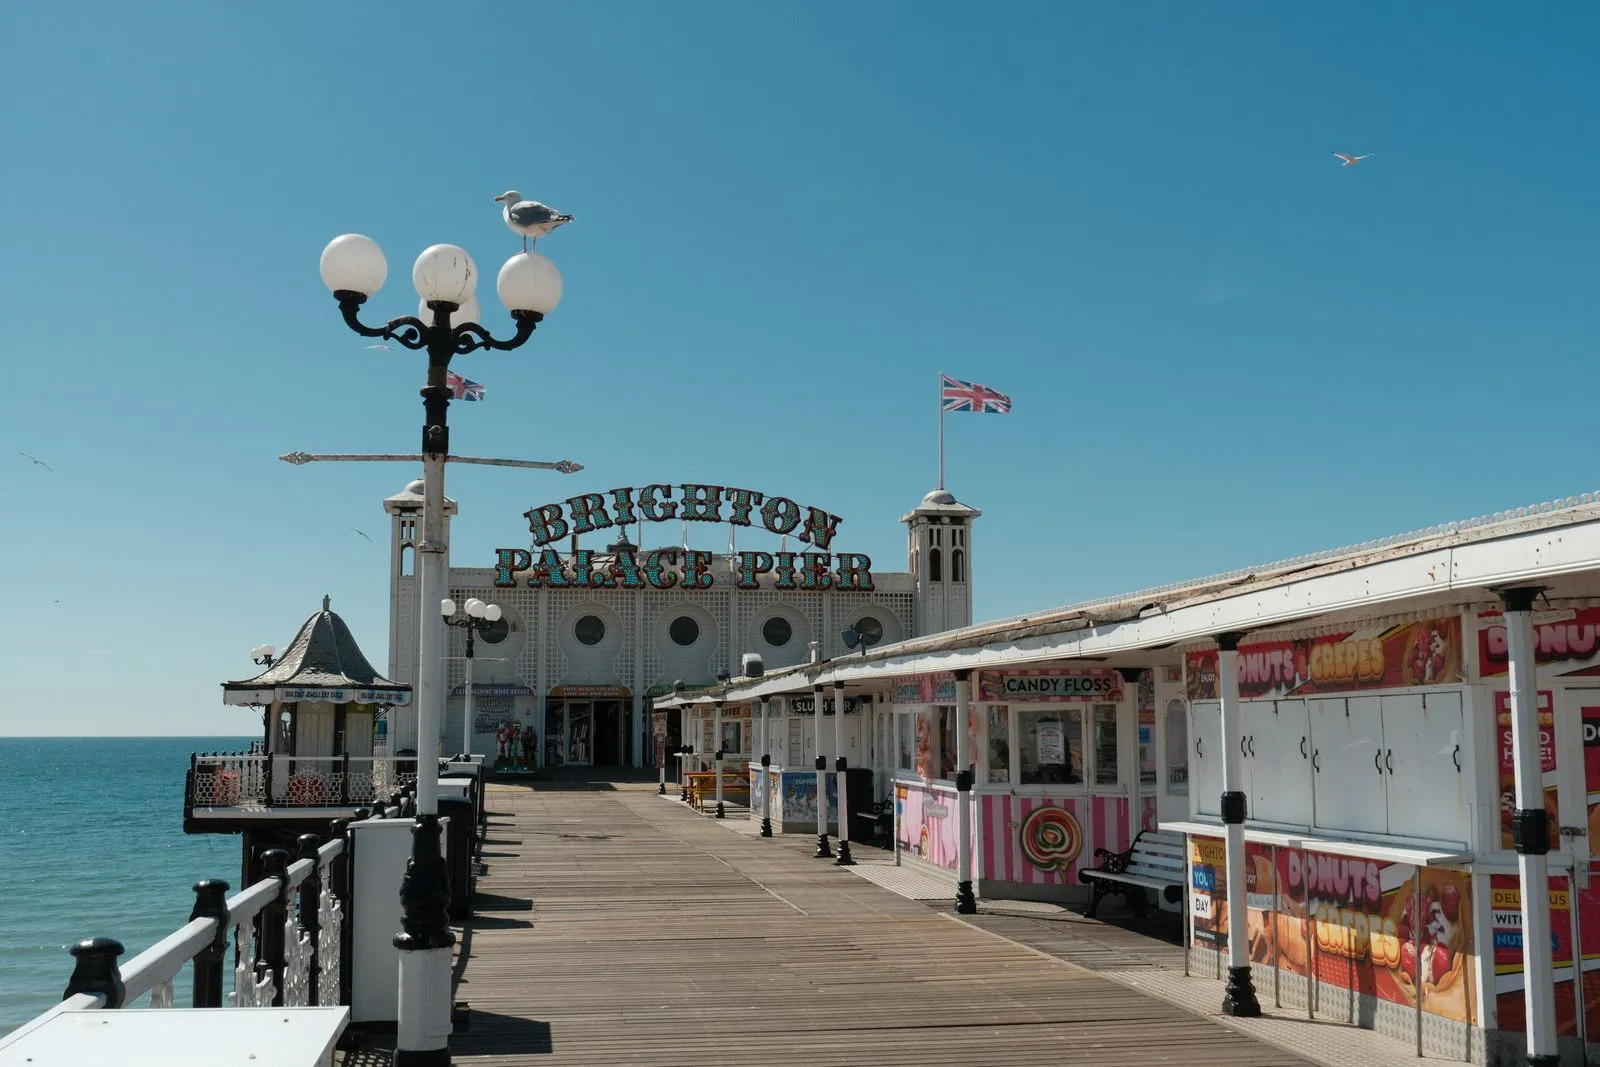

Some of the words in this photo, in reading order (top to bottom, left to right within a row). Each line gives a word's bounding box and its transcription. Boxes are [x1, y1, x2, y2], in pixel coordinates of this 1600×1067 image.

[523, 484, 843, 550] BRIGHTON
[494, 548, 714, 589] PALACE
[737, 551, 875, 592] PIER
[1487, 624, 1600, 655] DNU
[1238, 649, 1294, 683] ONUTS
[1006, 678, 1061, 692] CANDY
[1064, 678, 1112, 692] FLOSS
[721, 708, 741, 717] OFFEE
[796, 701, 828, 712] SLUH
[831, 700, 851, 711] BR
[1503, 731, 1550, 744] SD
[1503, 748, 1552, 760] HE!
[1194, 844, 1225, 860] BRIGHTO
[1194, 870, 1214, 887] YOUR
[1288, 851, 1380, 902] DONUTS
[1195, 898, 1209, 913] DAY
[1494, 892, 1566, 906] DELUS
